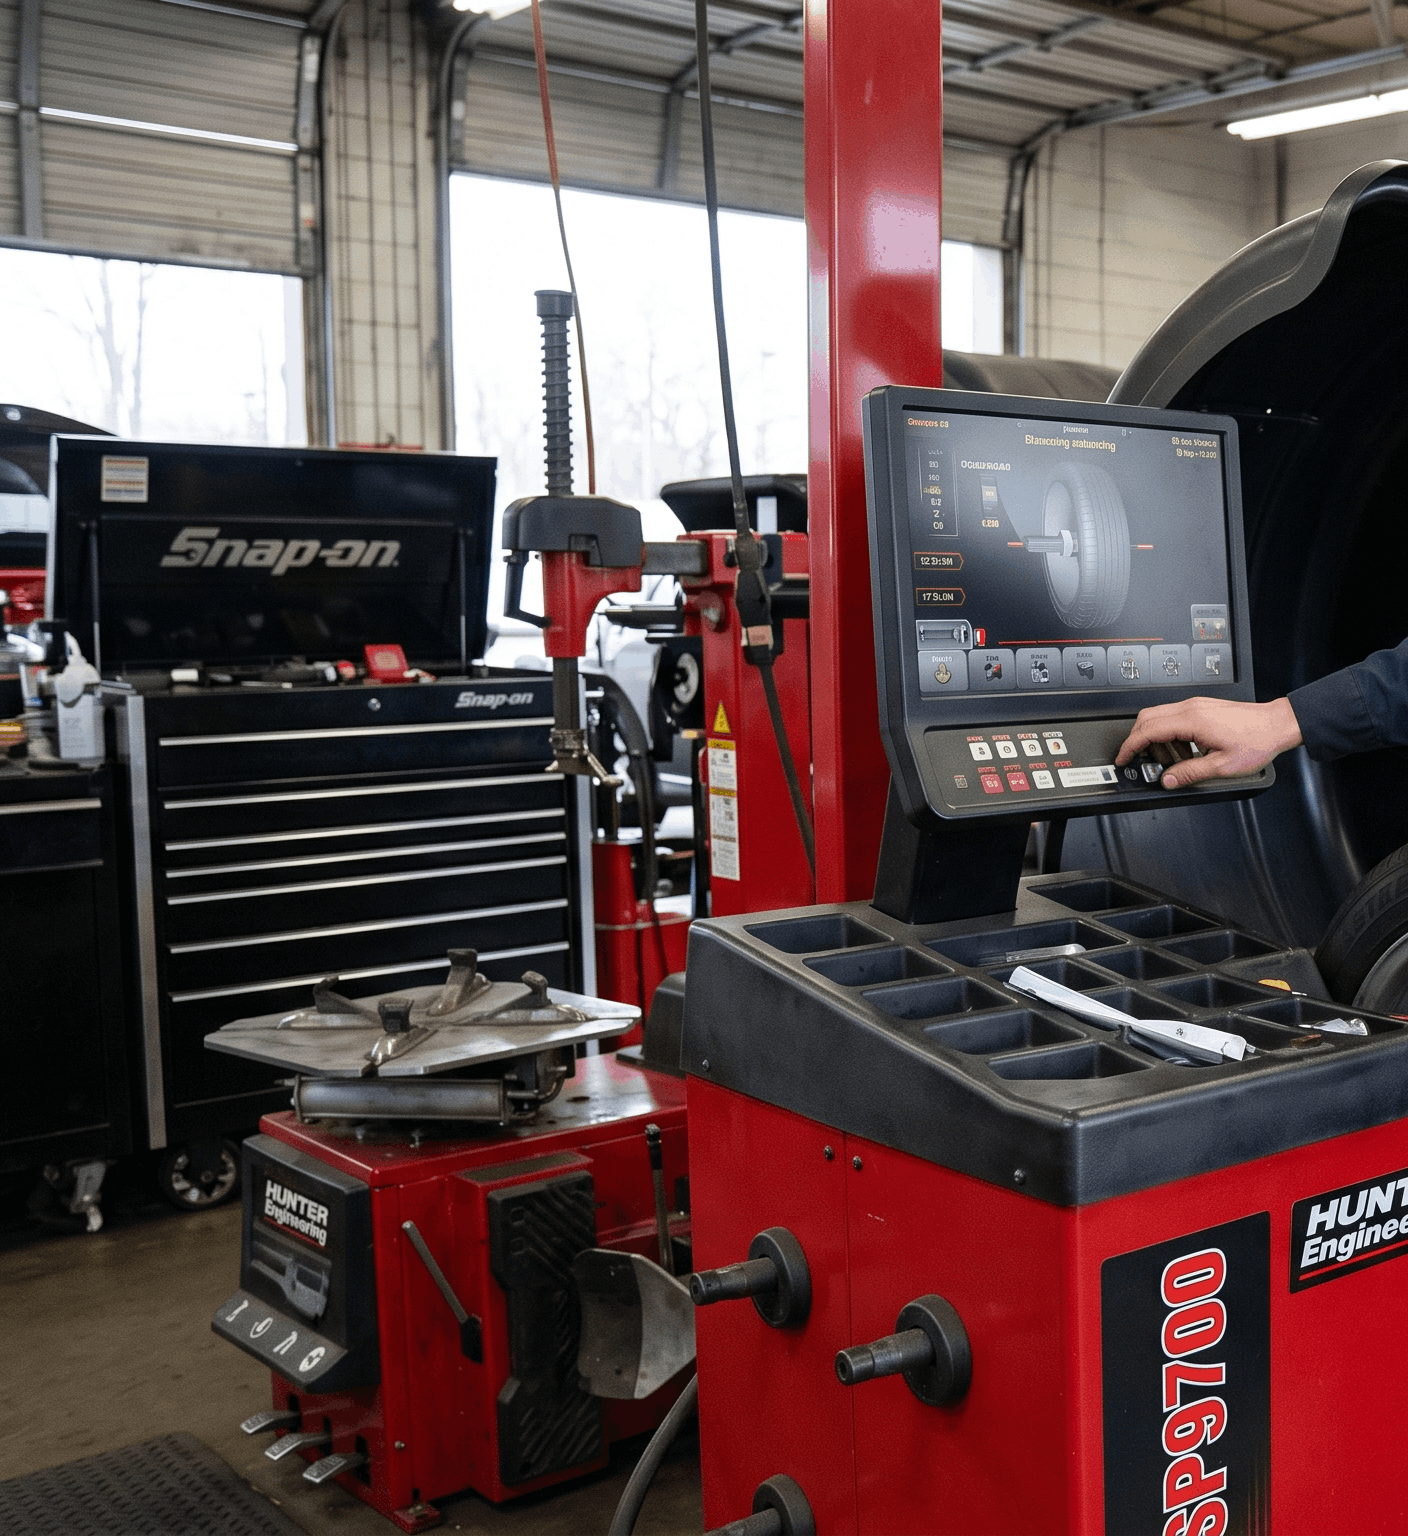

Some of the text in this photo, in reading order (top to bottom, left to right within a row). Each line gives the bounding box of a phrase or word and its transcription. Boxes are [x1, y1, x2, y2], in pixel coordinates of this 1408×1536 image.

[160, 526, 400, 576] Snap-on
[455, 691, 534, 709] Snap-on
[265, 1179, 329, 1227] HUNTER
[1161, 1247, 1229, 1536] SP9700
